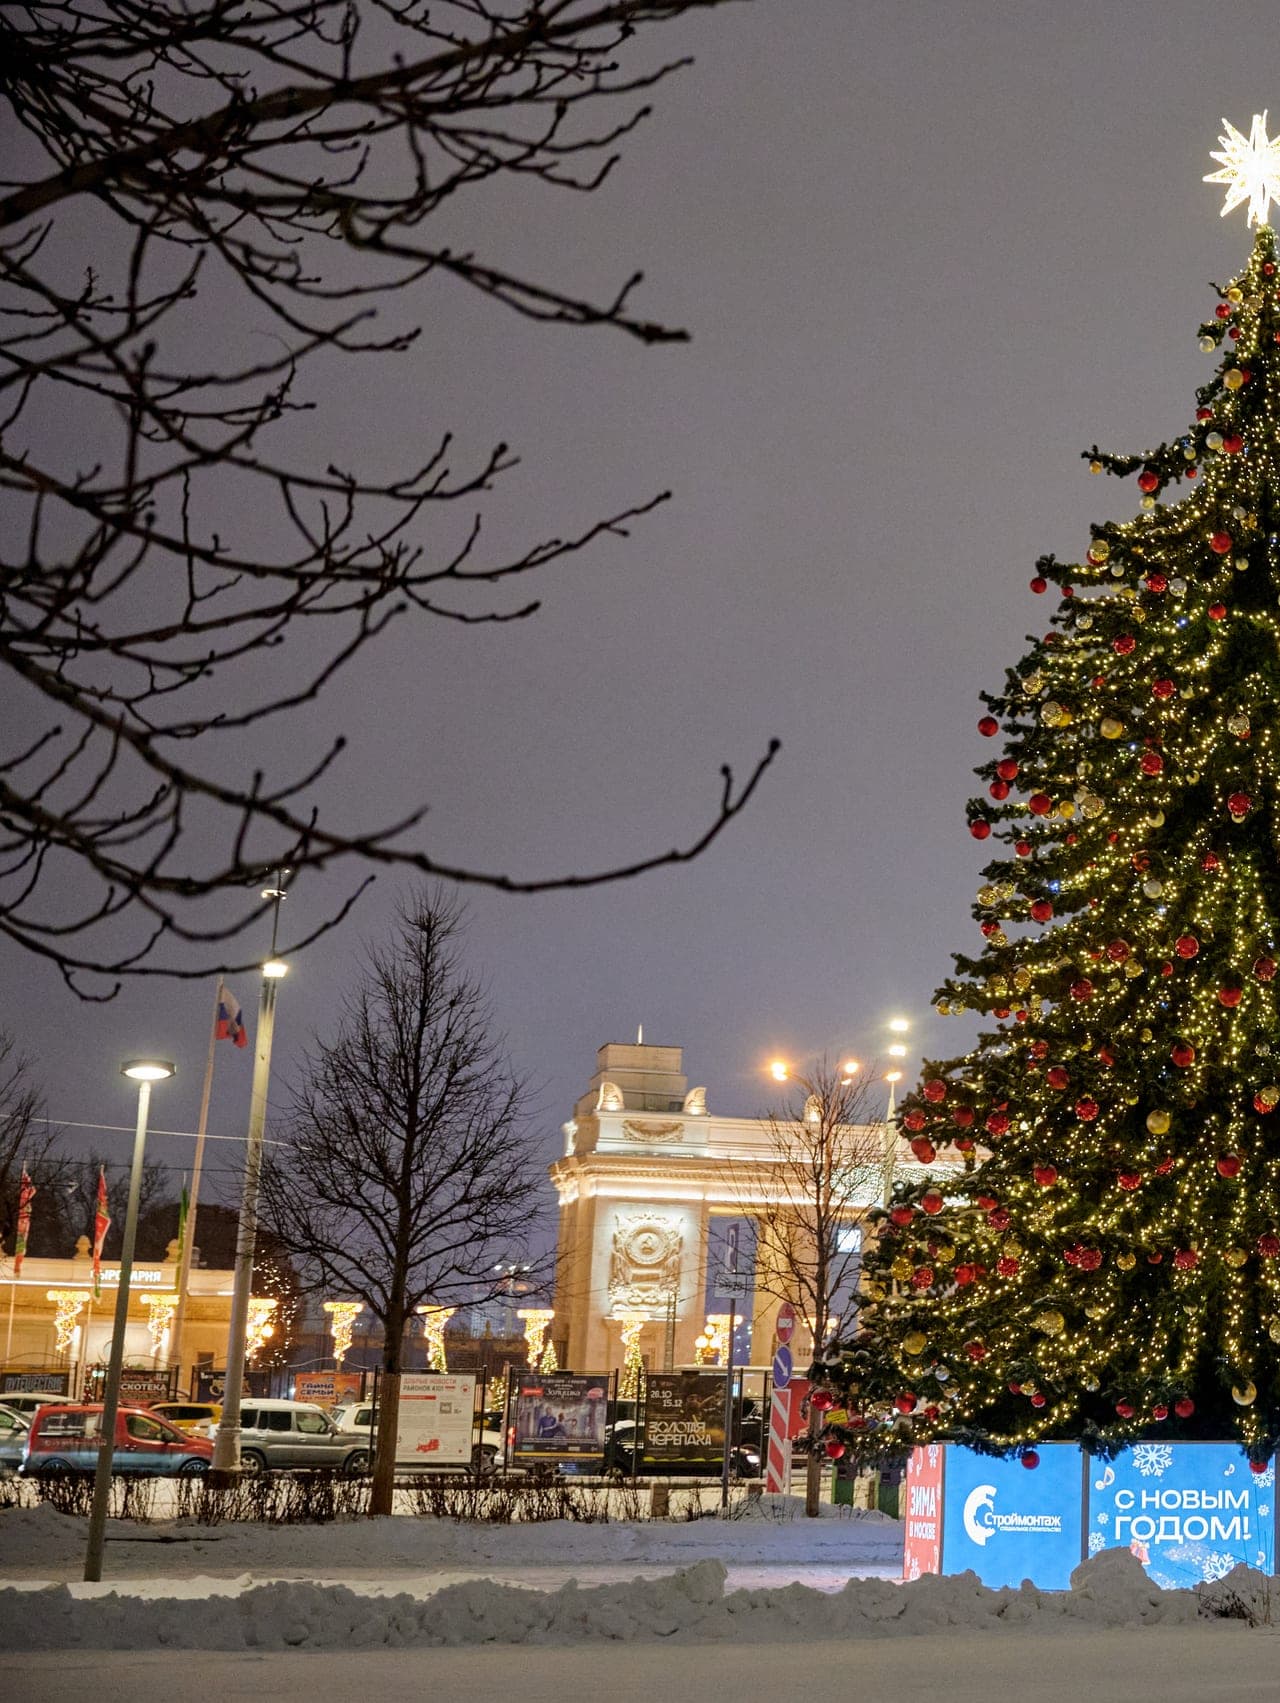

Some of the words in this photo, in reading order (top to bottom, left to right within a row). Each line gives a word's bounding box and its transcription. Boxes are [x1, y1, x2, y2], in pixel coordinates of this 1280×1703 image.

[90, 1269, 161, 1281] ЫРОАРНЯ
[121, 1383, 167, 1391] СКОТЕКА
[648, 1421, 706, 1433] ЗОЛОТАЯ
[648, 1434, 712, 1446] ЧЕРЕПАХА
[910, 1486, 936, 1517] ЗИМА
[1114, 1489, 1135, 1509] С
[1141, 1489, 1249, 1509] НОВЫМ
[984, 1512, 1062, 1528] Строймонтаж
[909, 1521, 913, 1537] В
[914, 1522, 936, 1540] МОСКВЕ
[1115, 1516, 1250, 1544] ГОДОМ!
